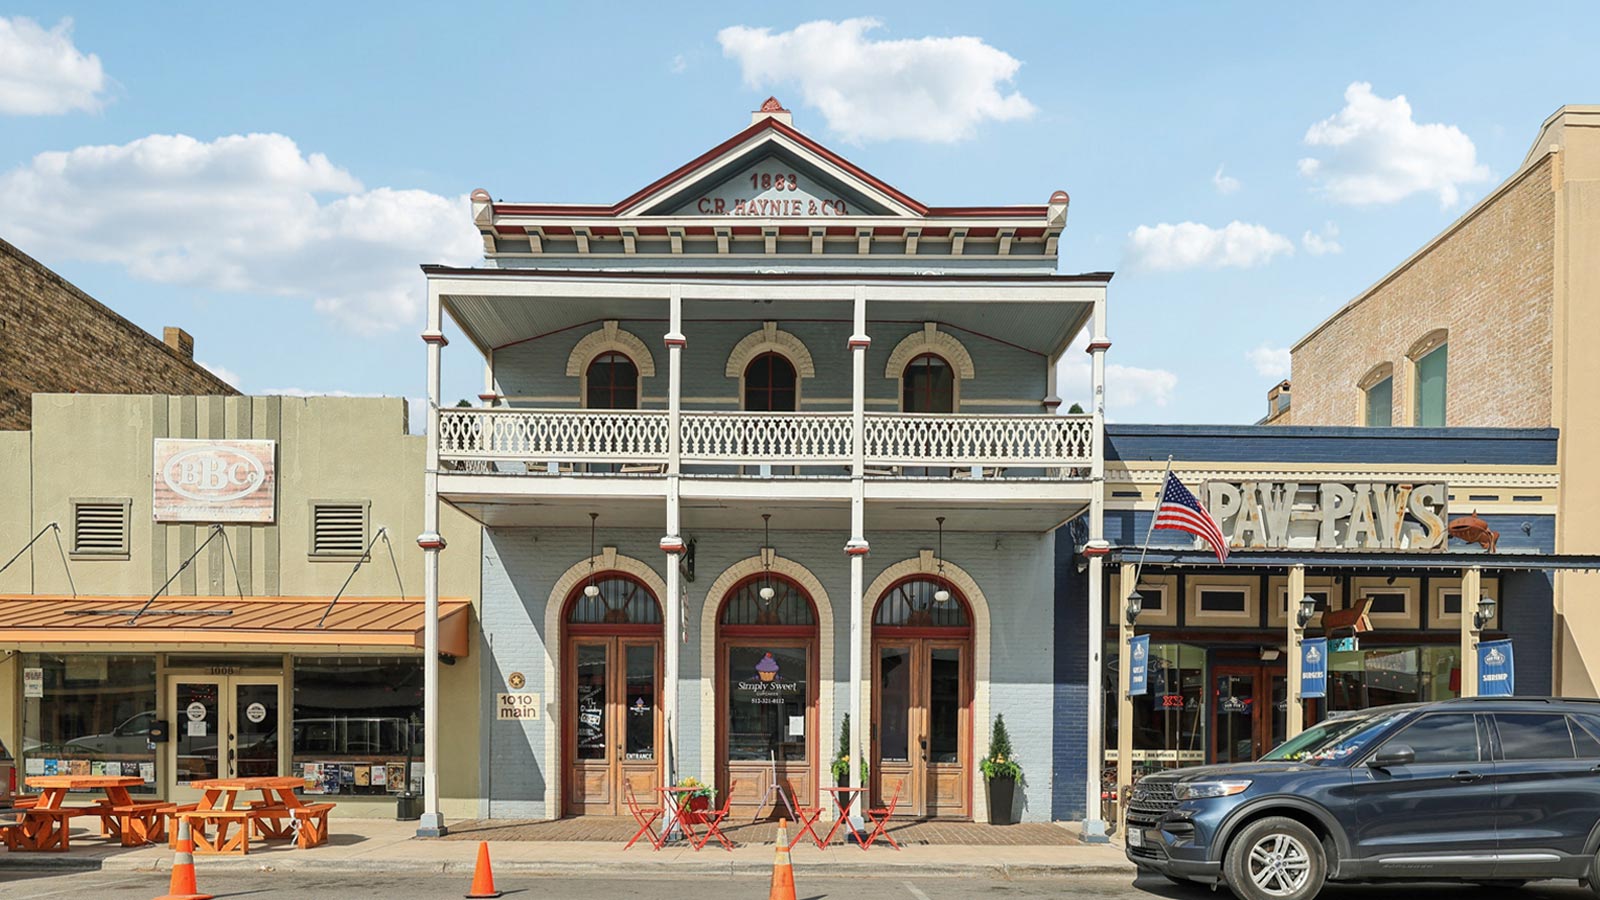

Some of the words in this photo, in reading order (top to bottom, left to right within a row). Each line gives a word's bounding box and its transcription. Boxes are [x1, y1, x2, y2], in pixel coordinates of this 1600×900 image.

[750, 173, 798, 191] 1883
[697, 198, 730, 216] C.R.
[734, 198, 803, 216] HAYNIE
[807, 199, 818, 216] &
[820, 199, 849, 216] CO.
[738, 681, 769, 692] Simply
[769, 681, 797, 692] Sweet
[501, 695, 532, 705] 1010
[501, 705, 536, 718] main
